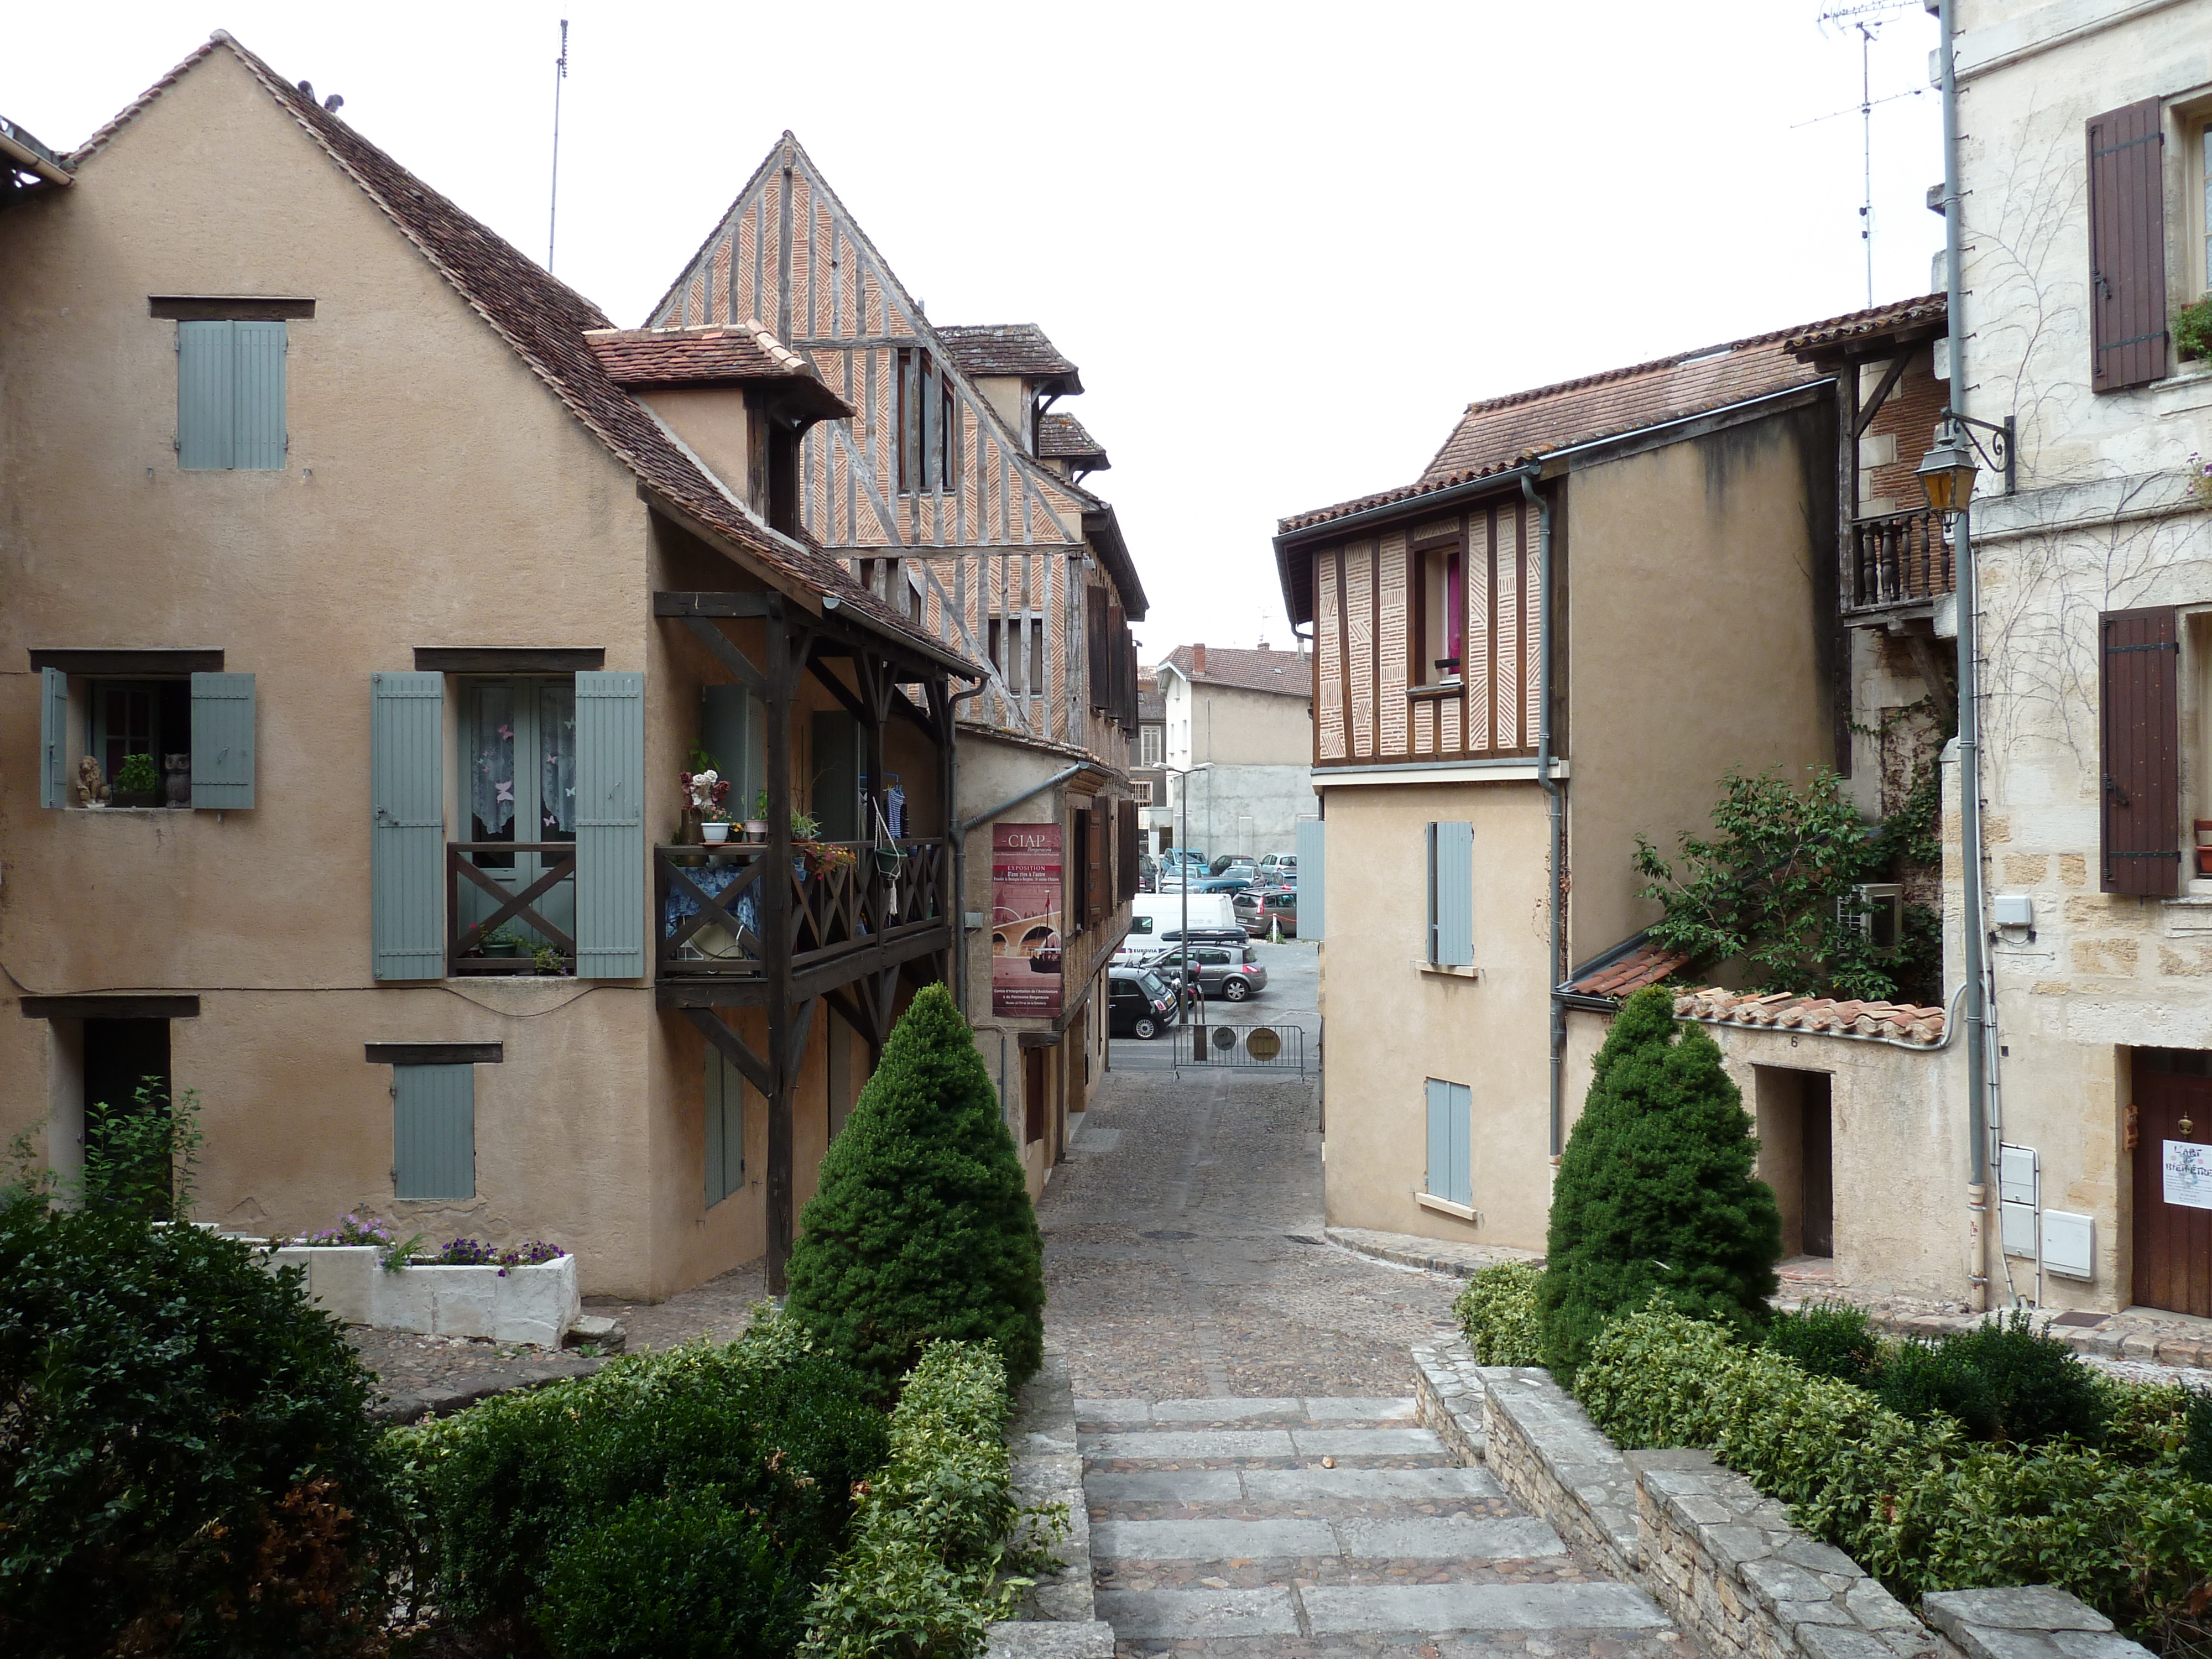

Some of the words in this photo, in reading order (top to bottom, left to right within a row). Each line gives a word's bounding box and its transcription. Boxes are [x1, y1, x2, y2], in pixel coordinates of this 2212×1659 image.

[1008, 834, 1045, 847] CIAP
[1791, 1036, 1798, 1048] 6
[2174, 1145, 2202, 1156] L'ART
